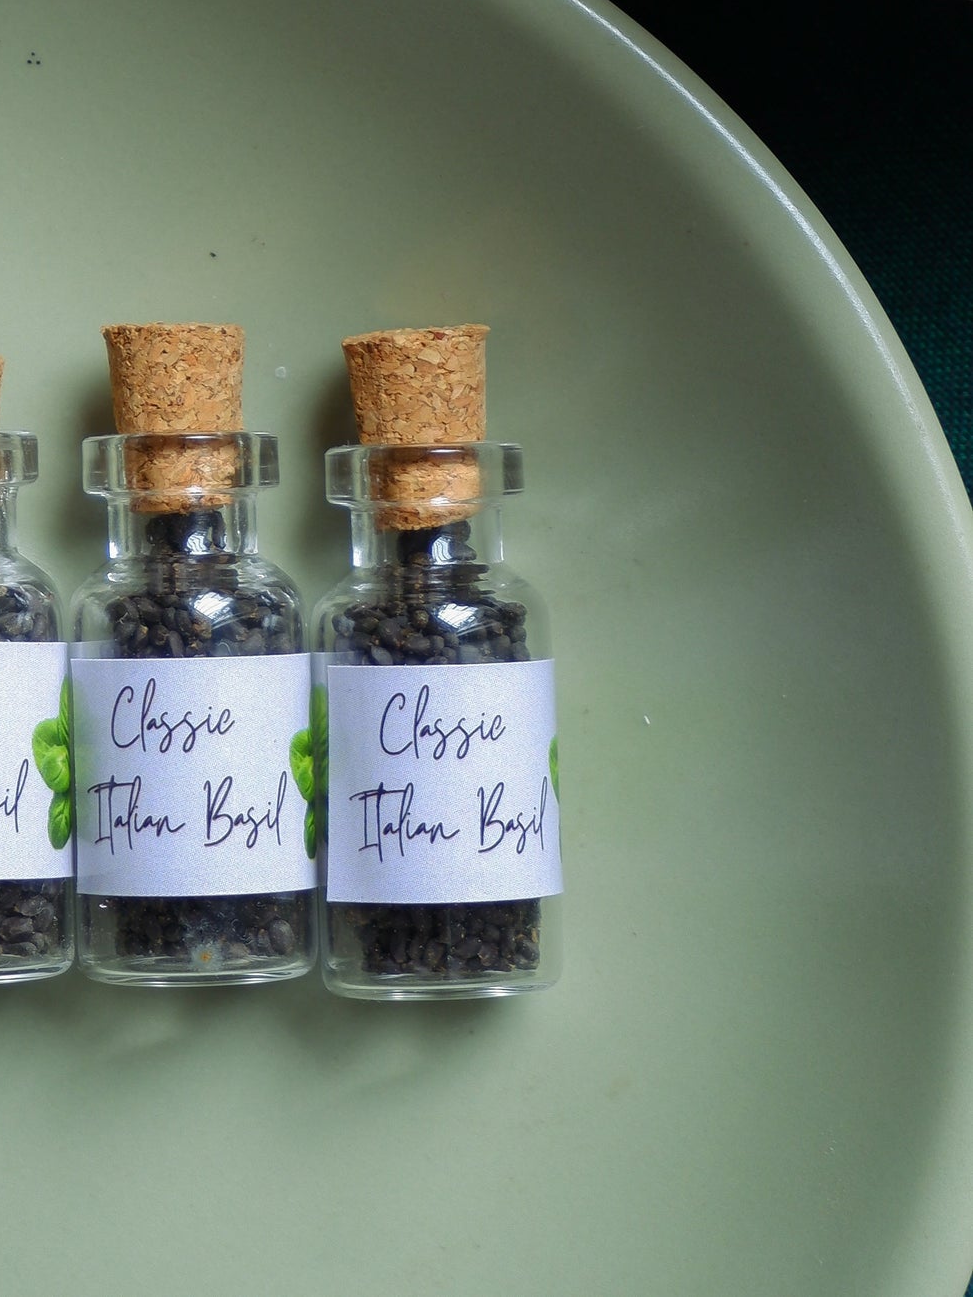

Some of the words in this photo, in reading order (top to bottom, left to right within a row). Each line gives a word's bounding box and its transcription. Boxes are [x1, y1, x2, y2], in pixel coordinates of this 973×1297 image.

[111, 677, 236, 753] Classic
[380, 684, 507, 760] Classic
[87, 774, 186, 855] Italian
[203, 770, 287, 849] Basil
[349, 781, 460, 863] Italian
[477, 775, 548, 854] Basil
